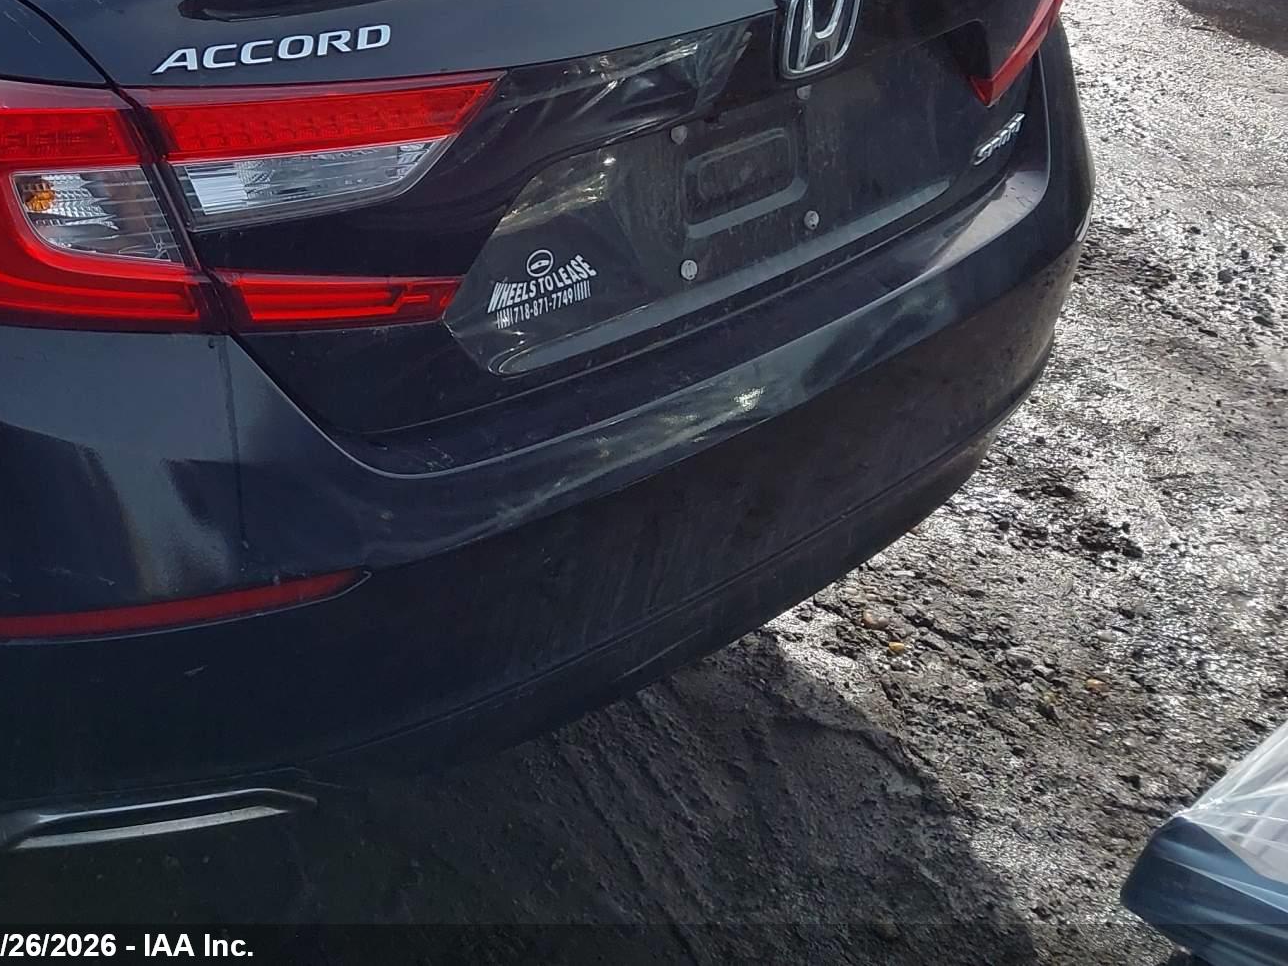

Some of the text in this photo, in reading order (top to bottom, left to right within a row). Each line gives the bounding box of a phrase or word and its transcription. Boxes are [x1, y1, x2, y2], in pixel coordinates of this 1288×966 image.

[151, 24, 391, 75] ACCORD
[487, 254, 597, 314] WHEELS TO LEASE
[513, 288, 574, 325] 718-871-7749
